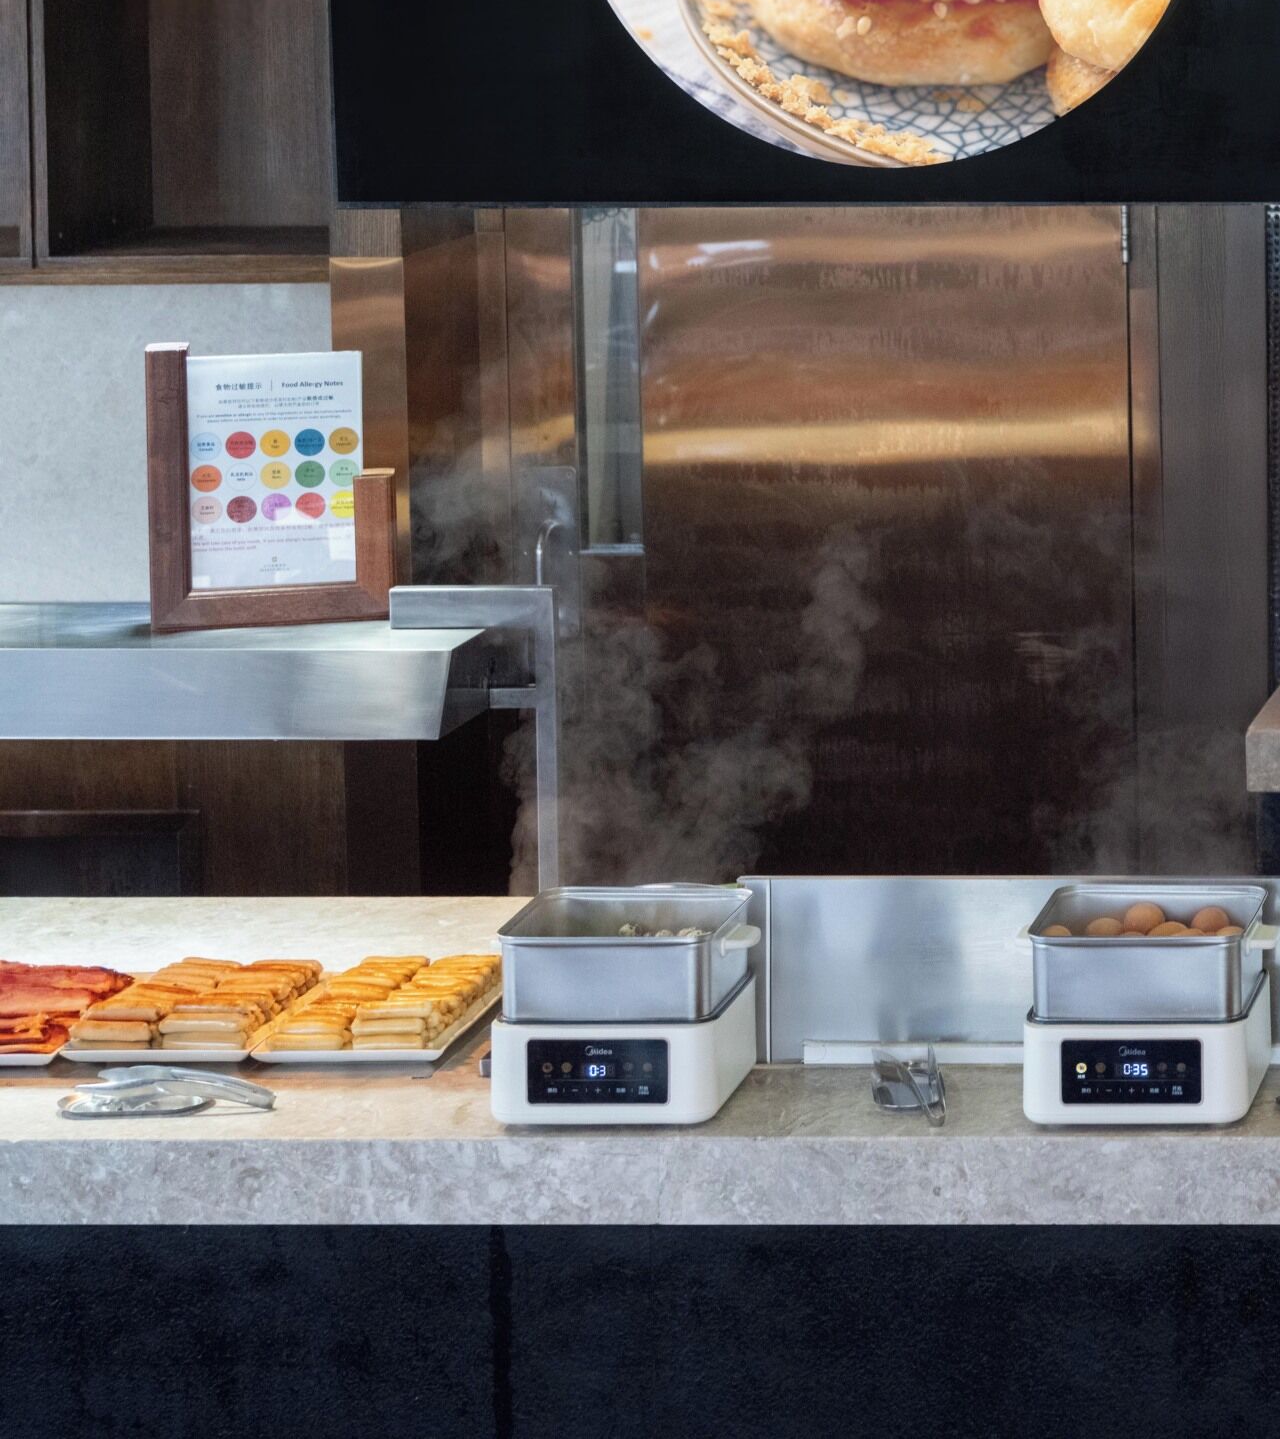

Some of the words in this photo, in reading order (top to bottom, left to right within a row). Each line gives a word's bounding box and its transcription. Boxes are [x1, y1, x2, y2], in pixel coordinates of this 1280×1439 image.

[281, 381, 299, 389] Food
[300, 380, 323, 389] Allergy
[323, 379, 344, 388] Notes
[585, 1045, 613, 1056] Midea
[1118, 1045, 1146, 1057] Midea
[1123, 1063, 1149, 1076] 0:35
